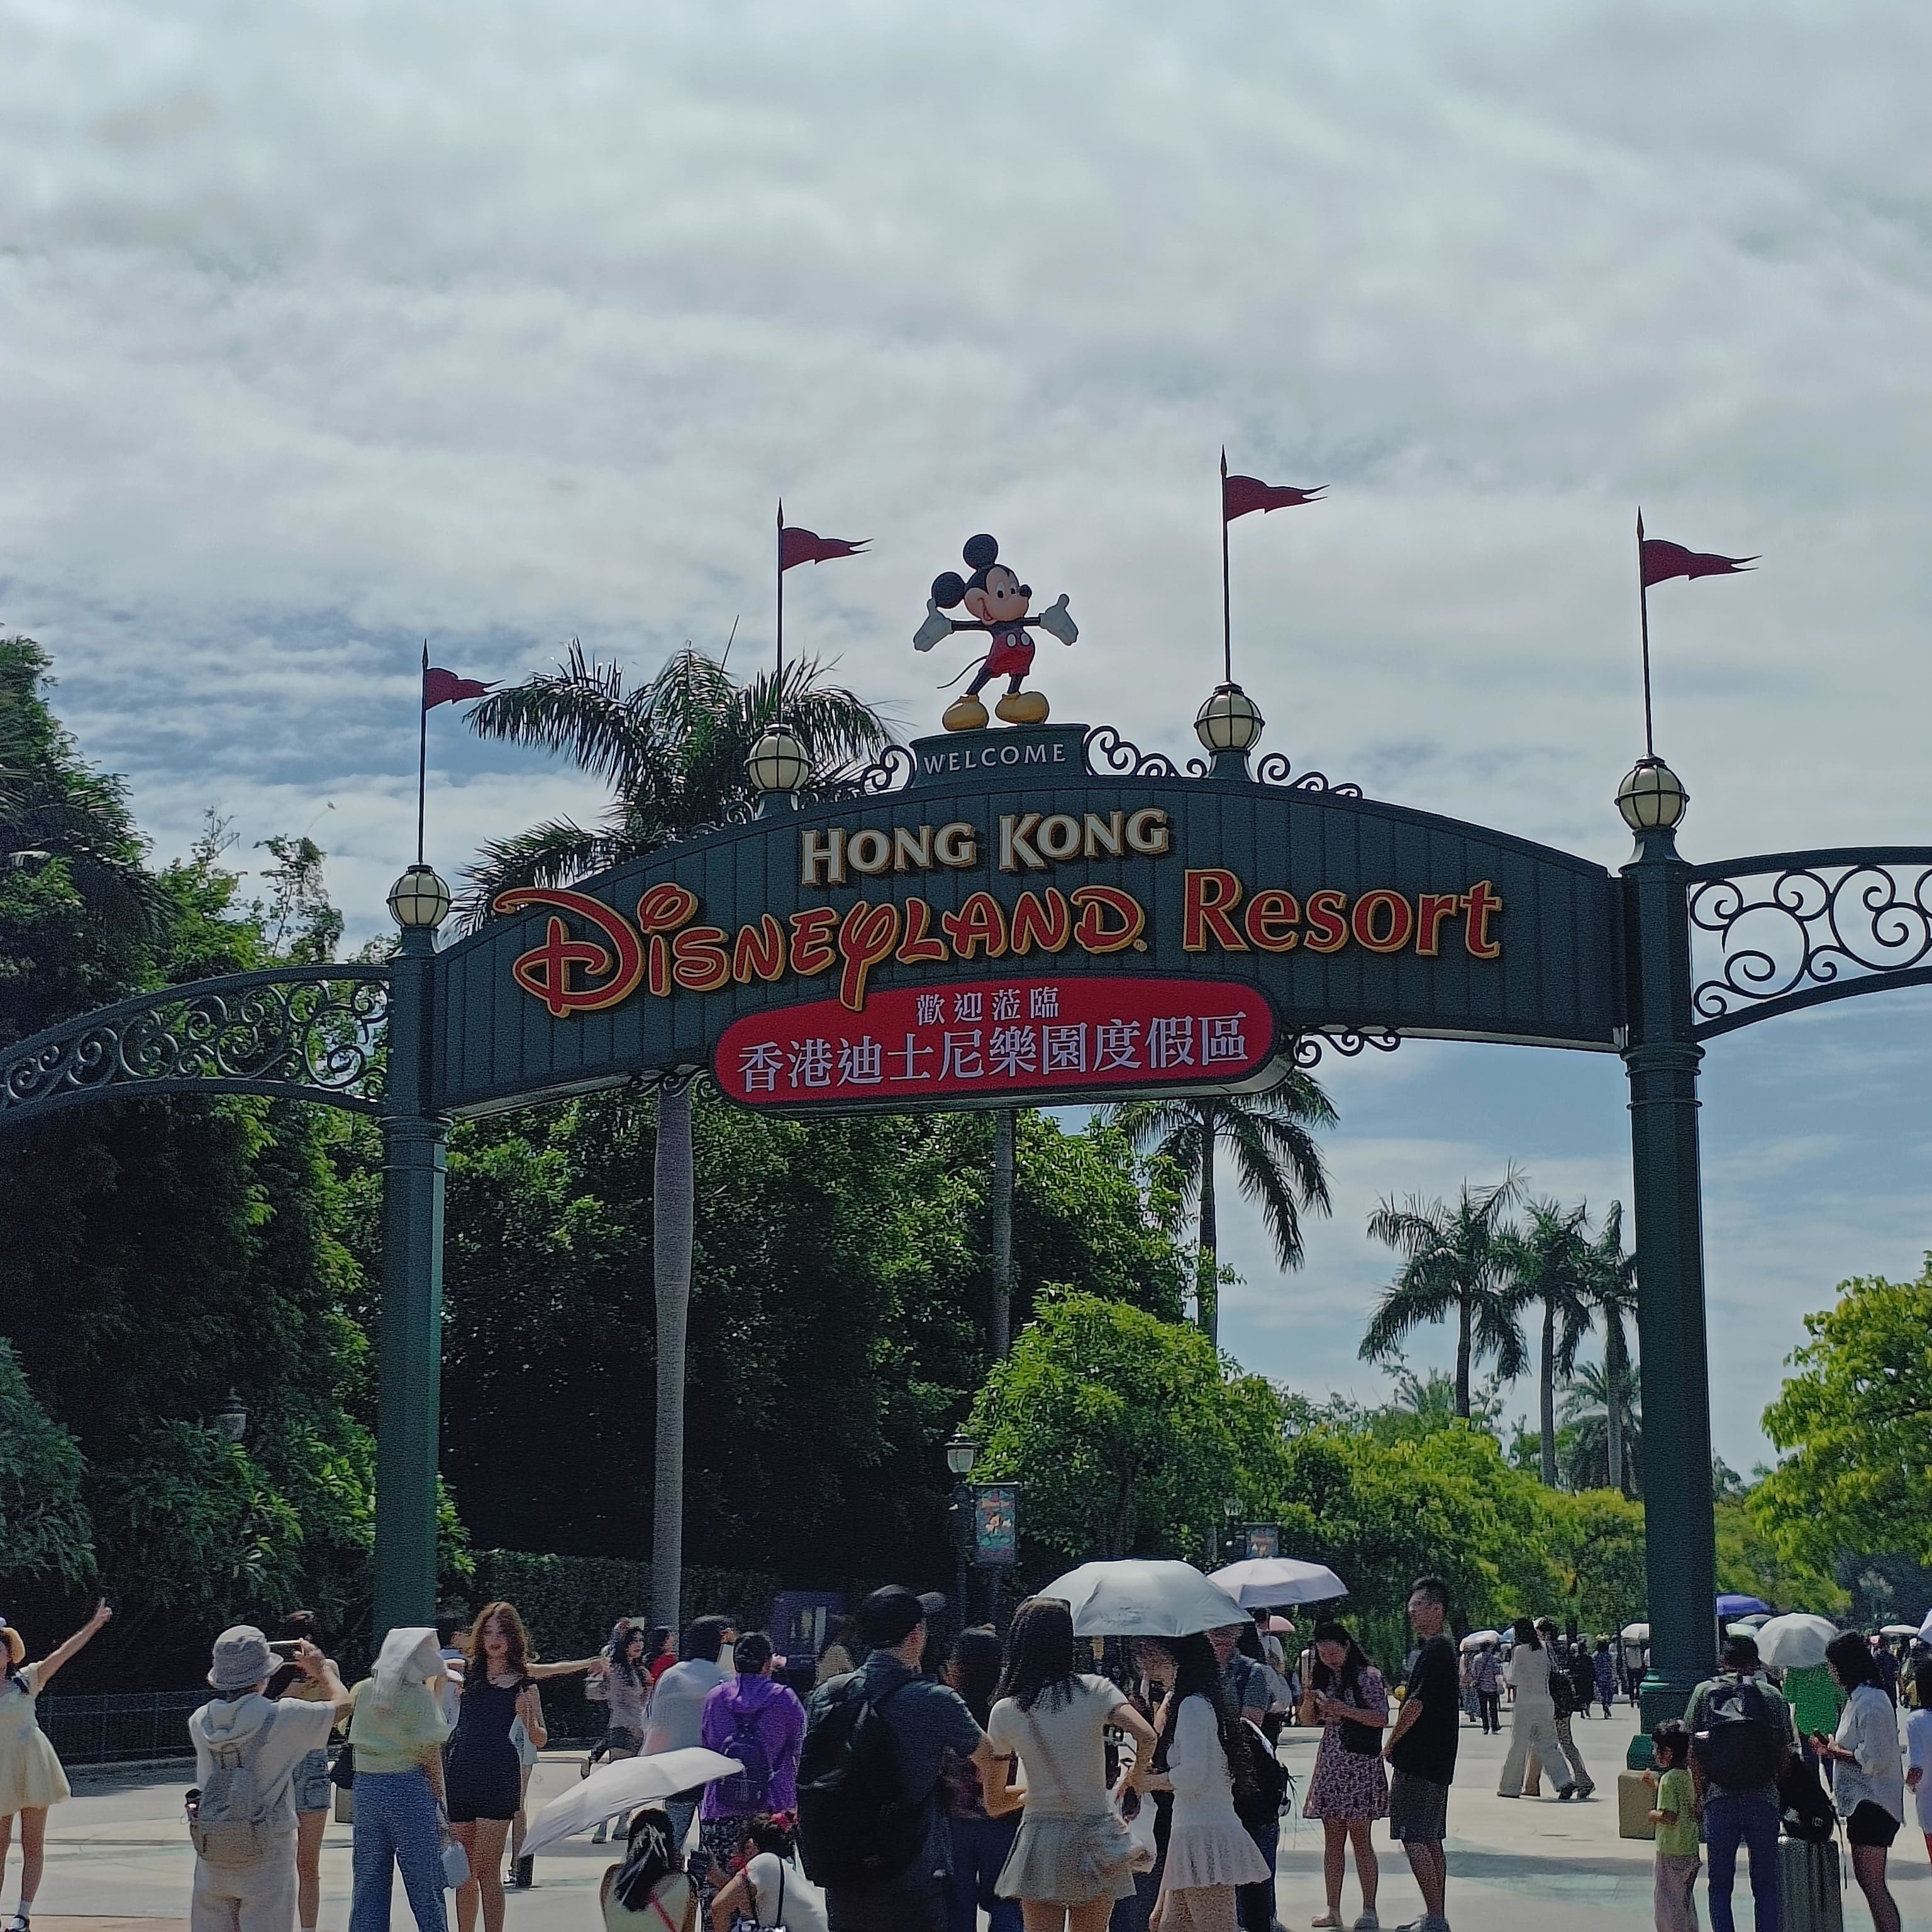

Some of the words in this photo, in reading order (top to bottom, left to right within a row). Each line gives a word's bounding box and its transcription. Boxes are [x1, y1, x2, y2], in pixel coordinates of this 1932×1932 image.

[924, 744, 1066, 774] WELCOME
[801, 822, 977, 886] HONG
[998, 808, 1170, 871] KONG
[1182, 868, 1504, 959] Resort
[737, 1011, 1250, 1093] 香港迪士尼樂園度假區
